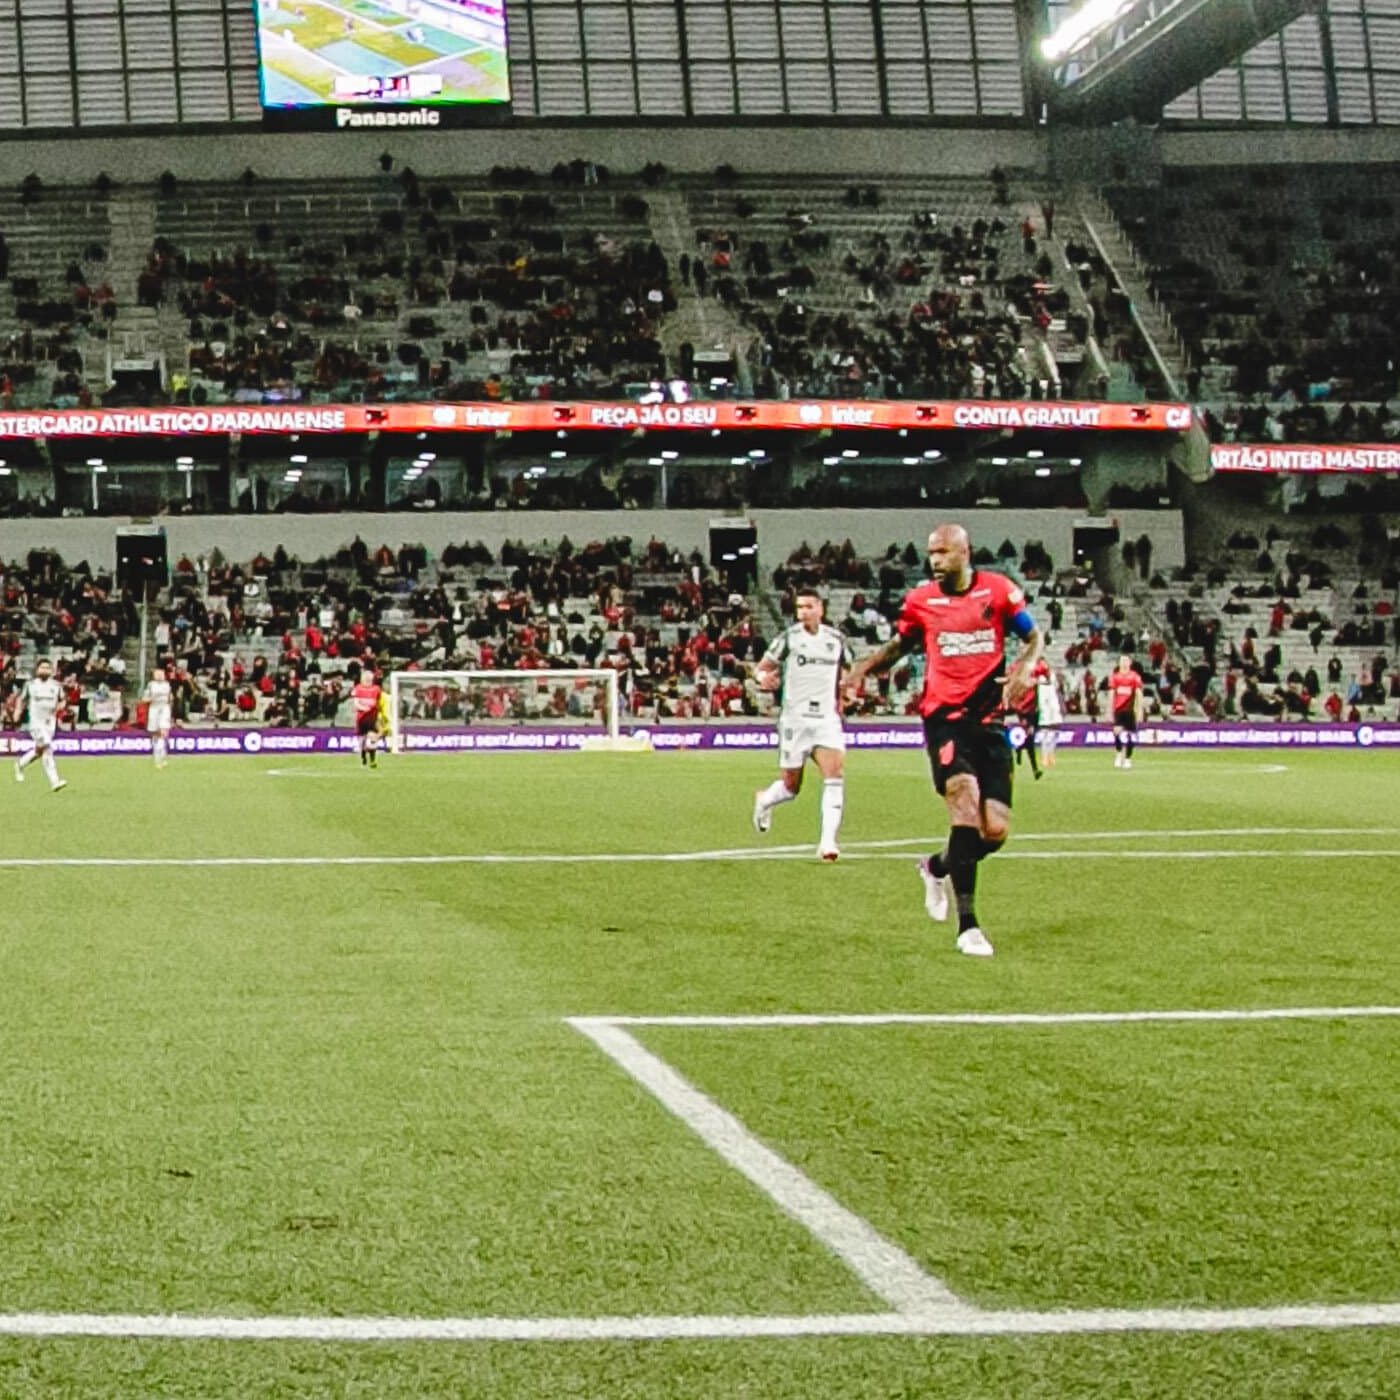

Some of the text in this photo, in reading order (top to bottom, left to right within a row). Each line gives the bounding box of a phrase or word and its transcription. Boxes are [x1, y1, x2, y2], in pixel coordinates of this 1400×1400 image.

[336, 107, 440, 127] Panasonic
[100, 410, 209, 434] ATHLETICO
[211, 409, 346, 432] PARANAENSE
[466, 407, 511, 426] inter
[592, 403, 717, 428] PEÇA JÁ O SEU
[831, 404, 875, 423] inter
[954, 407, 1024, 426] CONTA
[1269, 450, 1324, 469] INTER
